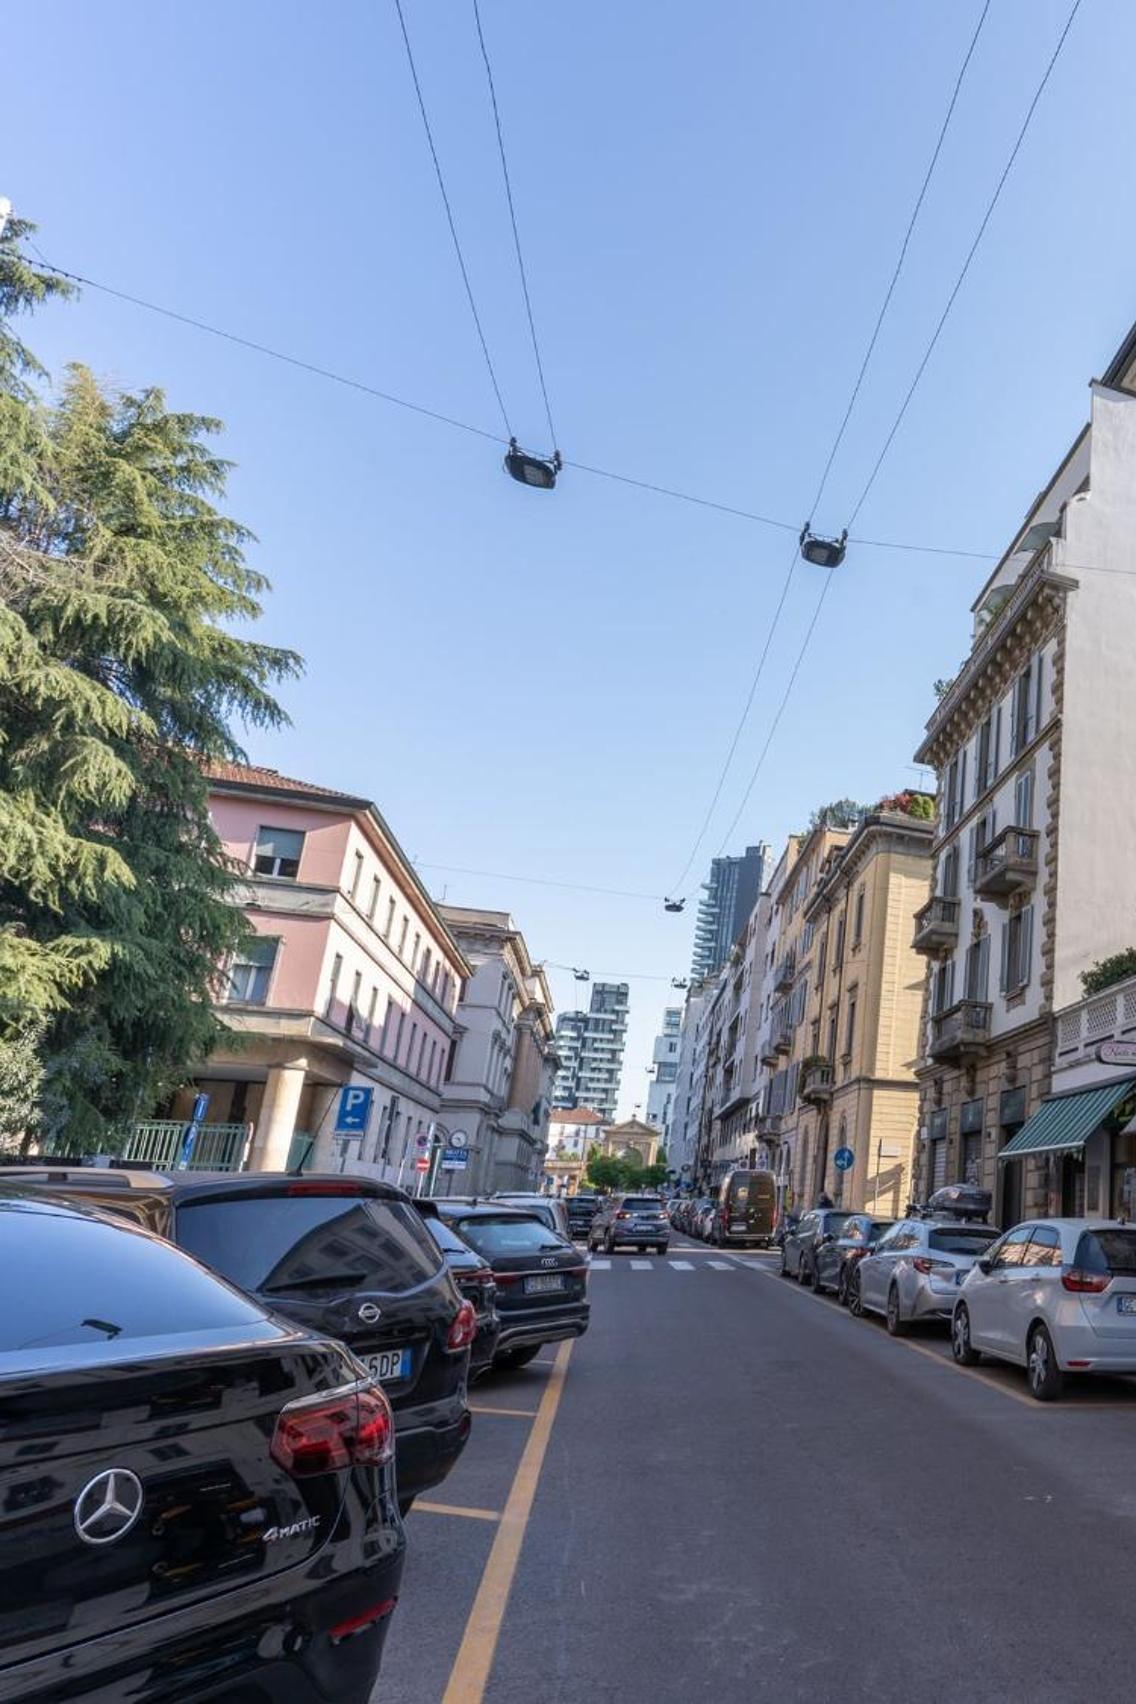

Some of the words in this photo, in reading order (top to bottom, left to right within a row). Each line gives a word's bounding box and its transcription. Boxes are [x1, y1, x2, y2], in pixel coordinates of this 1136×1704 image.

[346, 1089, 365, 1111] P
[361, 1352, 400, 1378] 6DP
[262, 1515, 320, 1542] 4MATIC
